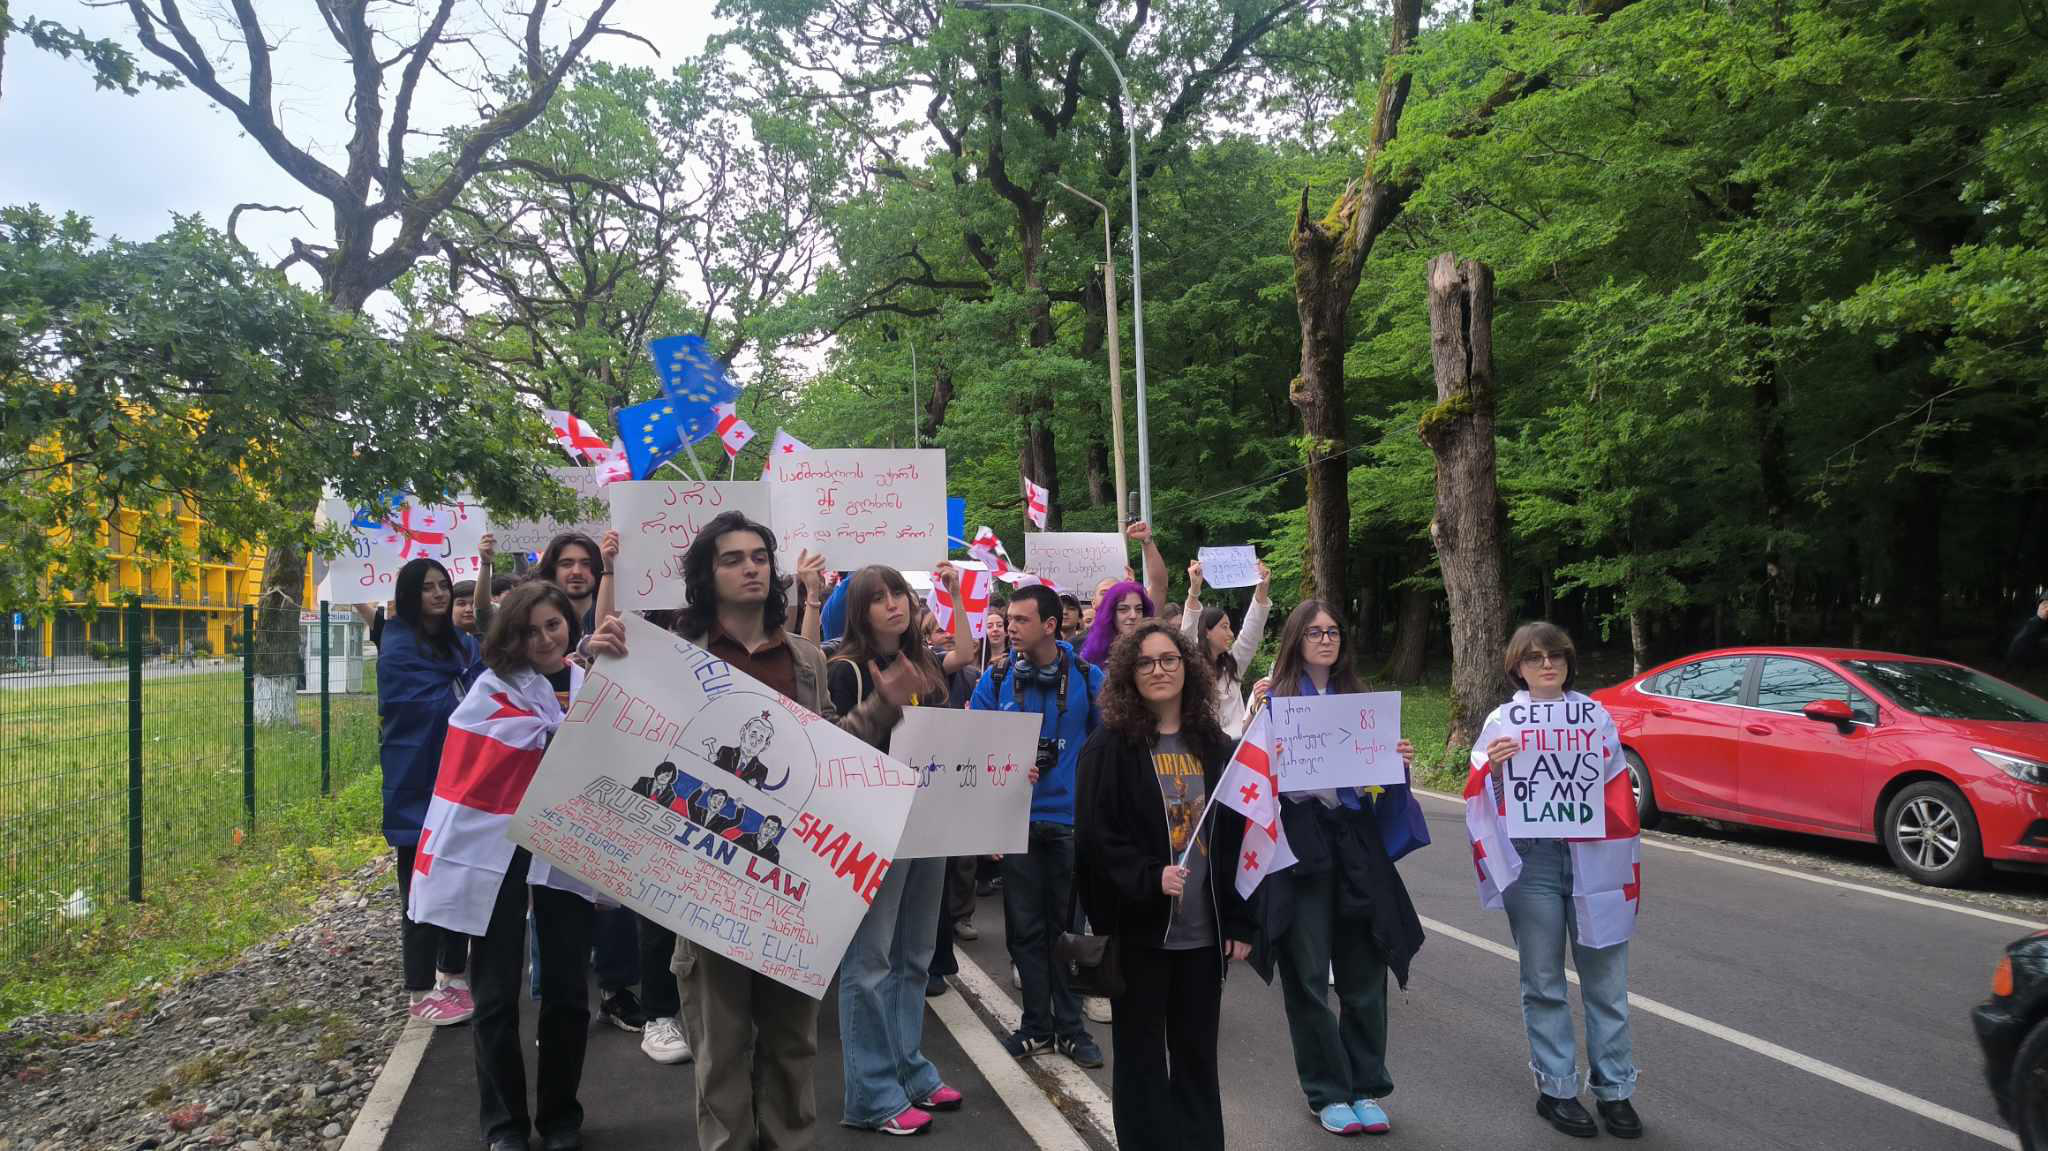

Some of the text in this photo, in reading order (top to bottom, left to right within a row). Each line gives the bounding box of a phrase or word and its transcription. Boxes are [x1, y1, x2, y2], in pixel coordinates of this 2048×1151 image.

[663, 482, 723, 506] არა
[1360, 708, 1376, 730] 83
[1509, 702, 1596, 726] GET UR
[1520, 728, 1597, 752] FILTHY
[1507, 752, 1600, 781] LAWS
[1513, 781, 1595, 802] OF MY
[1522, 801, 1594, 826] LAND
[540, 806, 566, 828] YES
[567, 820, 588, 840] TO
[584, 831, 633, 864] EUROPE
[583, 774, 739, 866] RUSSIAN
[744, 855, 808, 902] LAW
[628, 826, 682, 860] SHAME
[792, 811, 892, 906] SHAME
